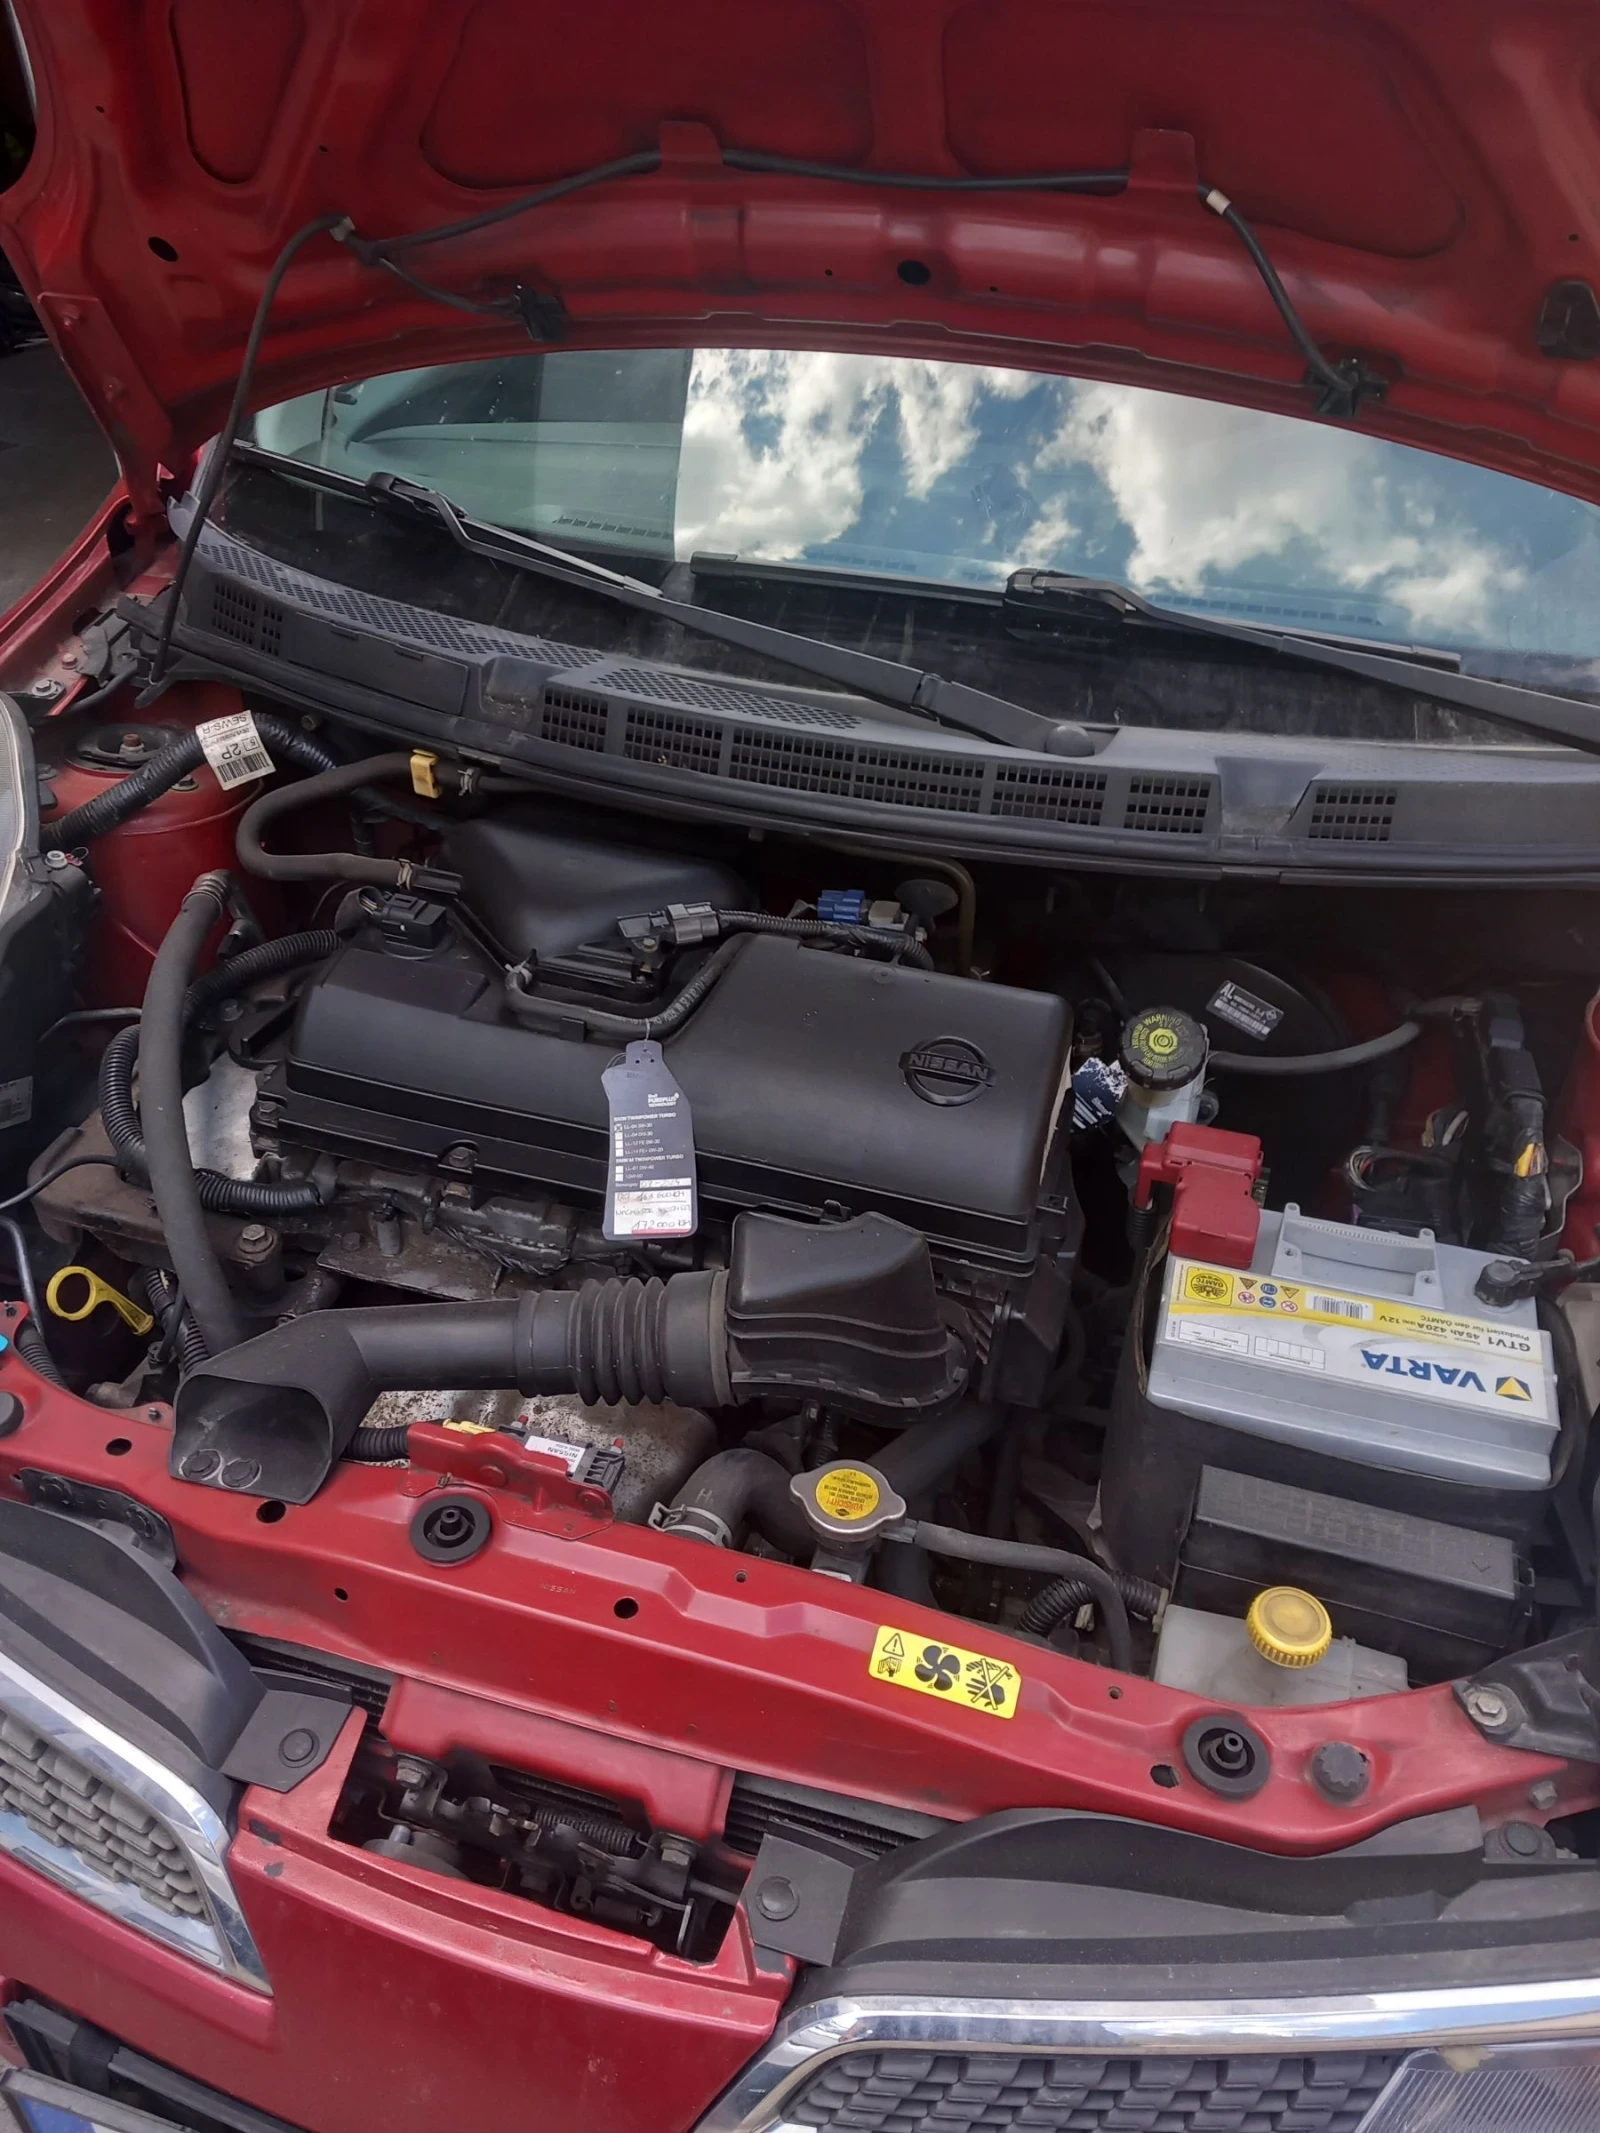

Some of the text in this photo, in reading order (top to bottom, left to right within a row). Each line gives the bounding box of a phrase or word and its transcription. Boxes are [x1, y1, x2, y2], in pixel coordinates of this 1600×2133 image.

[222, 743, 241, 760] 2P
[1220, 983, 1236, 1000] AL
[1143, 1013, 1182, 1026] WARNING
[908, 1053, 989, 1080] NISSAN
[1454, 1321, 1470, 1329] den
[1486, 1327, 1530, 1341] Produziert
[1487, 1336, 1531, 1352] GTV1
[1361, 1349, 1487, 1393] VARTA
[547, 1446, 578, 1458] NISSAN
